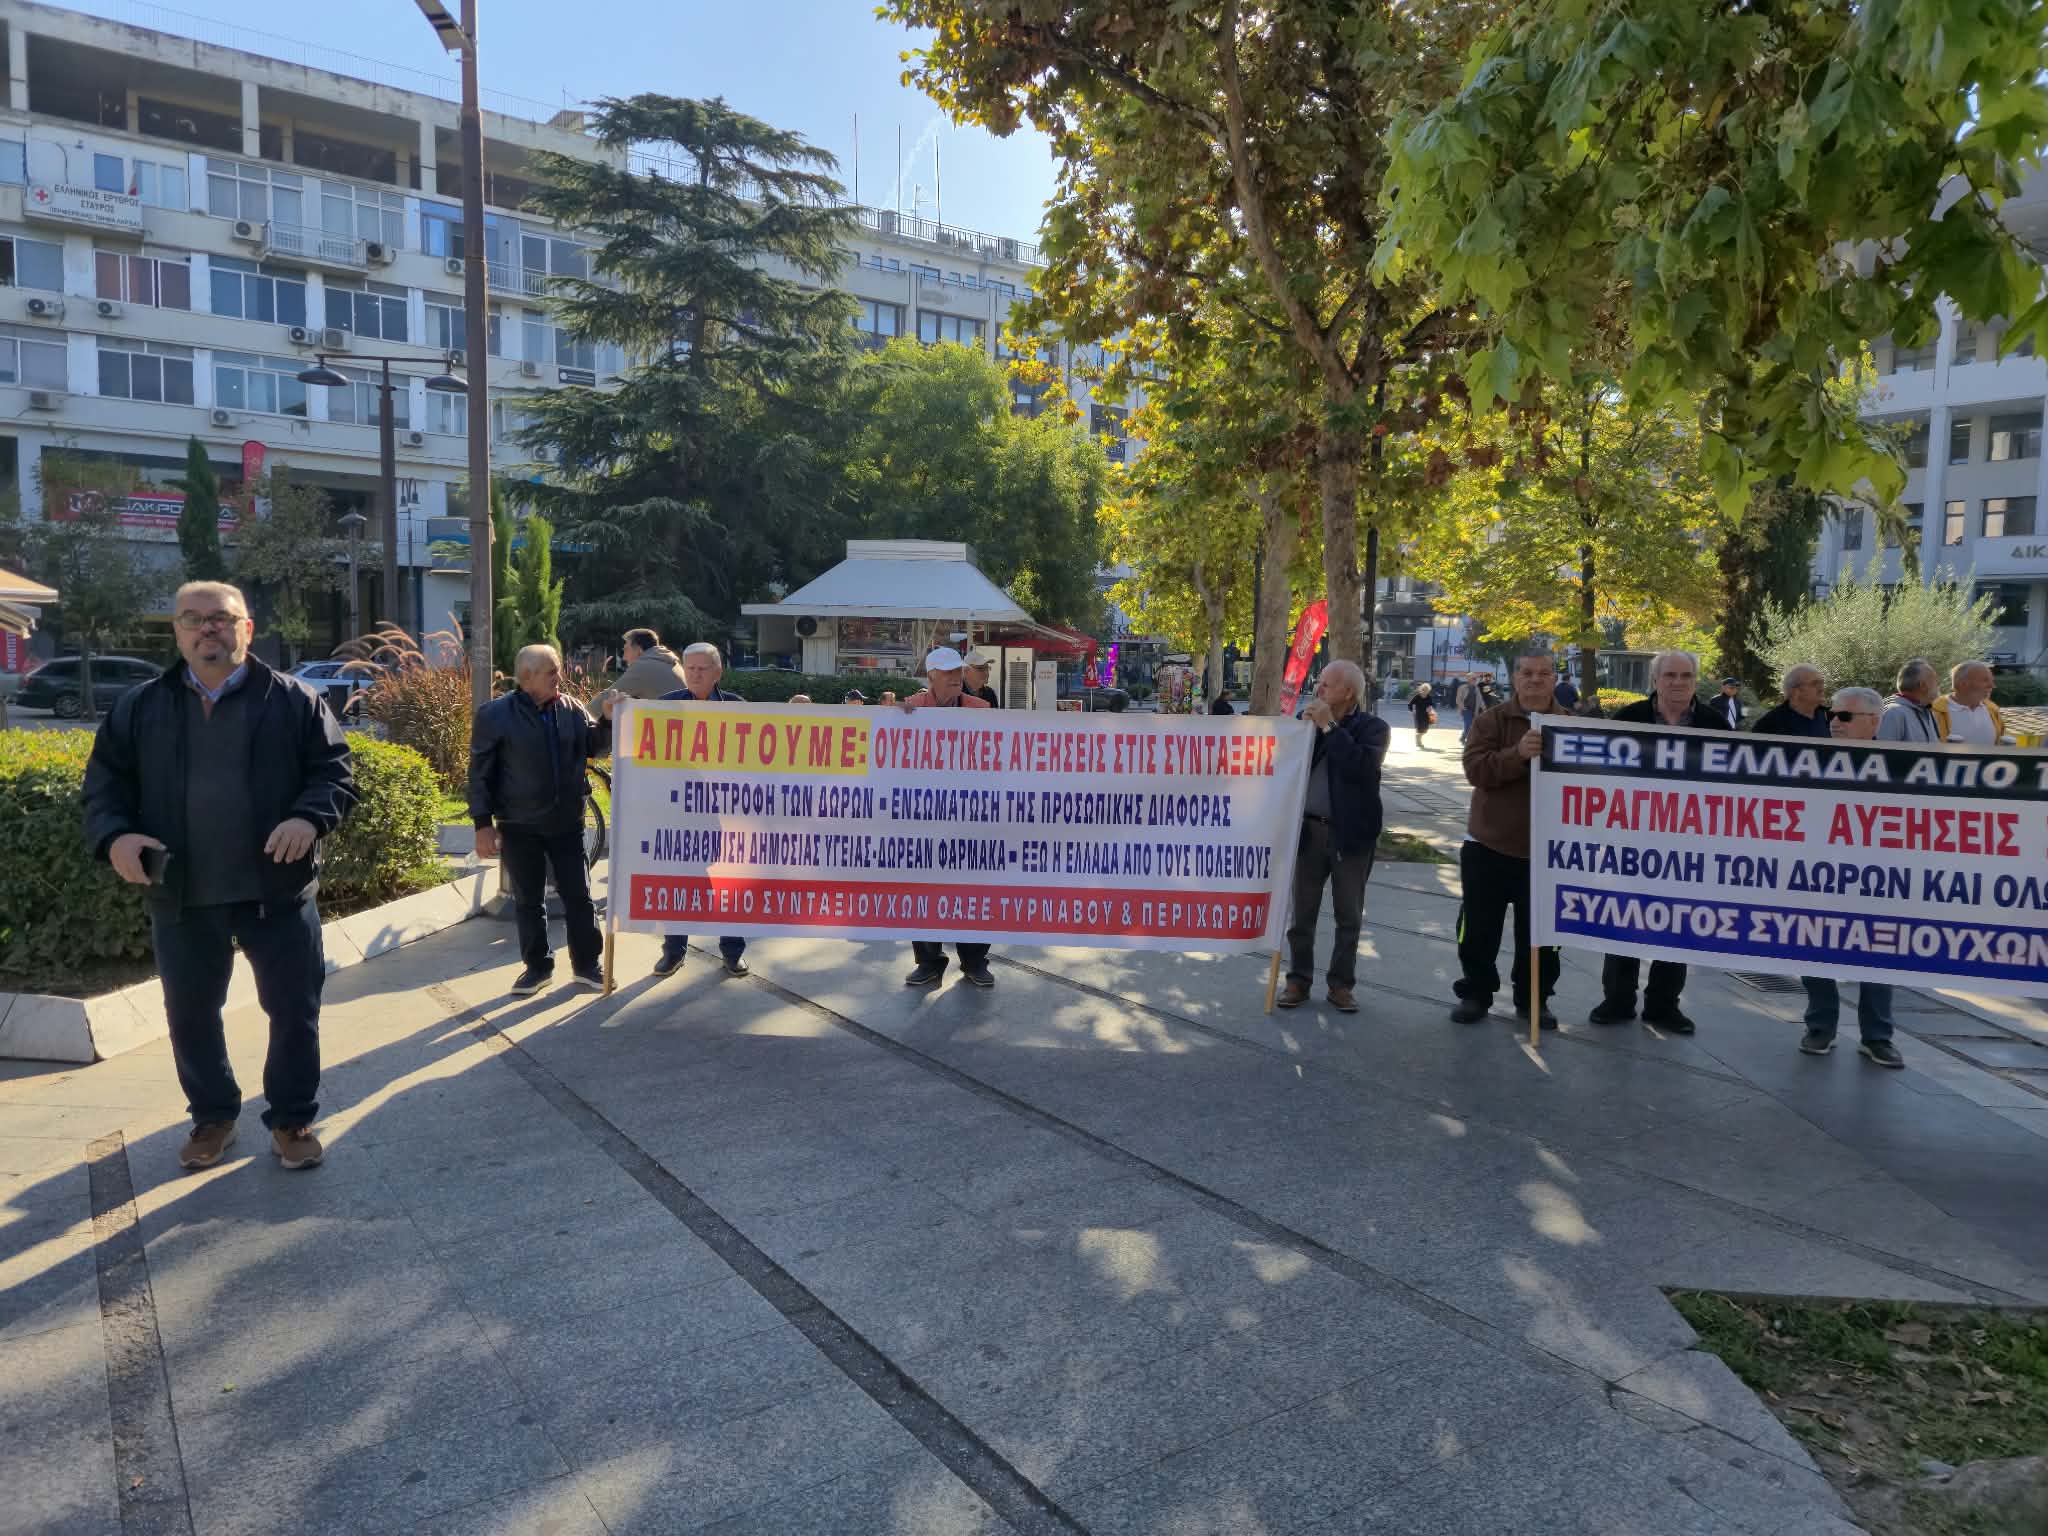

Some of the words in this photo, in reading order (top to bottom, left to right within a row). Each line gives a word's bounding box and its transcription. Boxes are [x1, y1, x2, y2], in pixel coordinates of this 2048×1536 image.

[80, 200, 114, 213] ΣΤΑΥΡΟΣ
[2010, 545, 2048, 558] ΔΙΚ
[638, 717, 867, 768] ΑΠΑΙΤΟΥΜΕ:
[875, 728, 1003, 772] ΟΥΣΙΑΣΤΙΚΕΣ
[1009, 732, 1106, 774] ΑΥΞΗΣΕΙΣ
[1113, 735, 1157, 775] ΣΤΙΣ
[1164, 735, 1276, 777] ΣΥΝΤΑΞΕΙΣ
[1553, 734, 1642, 768] ΕΞΩ
[1656, 739, 1686, 770] Η
[1700, 743, 1890, 783] ΕΛΛΑΔΑ
[1904, 756, 2020, 789] ΑΠΟ
[684, 781, 774, 816] ΕΠΙΣΤΡΟΦΗ
[782, 785, 813, 817] ΤΩΝ
[818, 787, 873, 819] ΔΩΡΩΝ
[891, 788, 1000, 822] ΕΝΣΩΜΑΤΩΣΗ
[1006, 791, 1035, 823] ΤΗΣ
[1041, 791, 1143, 826] ΠΡΟΣΩΠΙΚΗΣ
[1148, 795, 1231, 827] ΔΙΑΦΟΡΑΣ
[1561, 785, 1805, 842] ΠΡΑΓΜΑΤΙΚΕΣ
[1828, 803, 2020, 857] ΑΥΞΗΣΕΙΣ
[654, 829, 745, 864] ΑΝΑΒΑΘΜΙΣΗ
[749, 832, 820, 866] ΔΗΜΟΣΙΑΣ
[825, 836, 872, 868] ΥΓΕΙΑΣ
[877, 837, 933, 869] ΔΩΡΕΑΝ
[938, 839, 1006, 871] ΦΑΡΜΑΚΑ
[1022, 841, 1047, 872] ΕΞΩ
[1053, 842, 1062, 873] Η
[1066, 842, 1119, 875] ΕΛΛΑΔΑ
[1123, 844, 1151, 876] ΑΠΟ
[1156, 845, 1191, 877] ΤΟΥΣ
[1195, 846, 1271, 879] ΠΟΛΕΜΟΥΣ
[1547, 840, 1704, 883] ΚΑΤΑΒΟΛΗ
[1714, 854, 1779, 890] ΤΩΝ
[1787, 859, 1912, 900] ΔΩΡΩΝ
[1922, 868, 1982, 905] ΚΑΙ
[1993, 874, 2048, 910] ΟΛ
[644, 887, 754, 913] ΣΩΜΑΤΕΙΟ
[763, 890, 929, 918] ΣΥΝΤΑΞΙΟΥΧΩΝ
[1000, 897, 1113, 925] ΤΥΡΝΑΒΟΥ
[1121, 902, 1132, 926] &
[1141, 902, 1265, 929] ΠΕΡΙΧΩΡΩΝ
[1560, 892, 1739, 940] ΣΥΛΛΟΓΟΣ
[1748, 914, 2048, 966] ΣΥΝΤΑΞΙΟΥΧΩΝ
